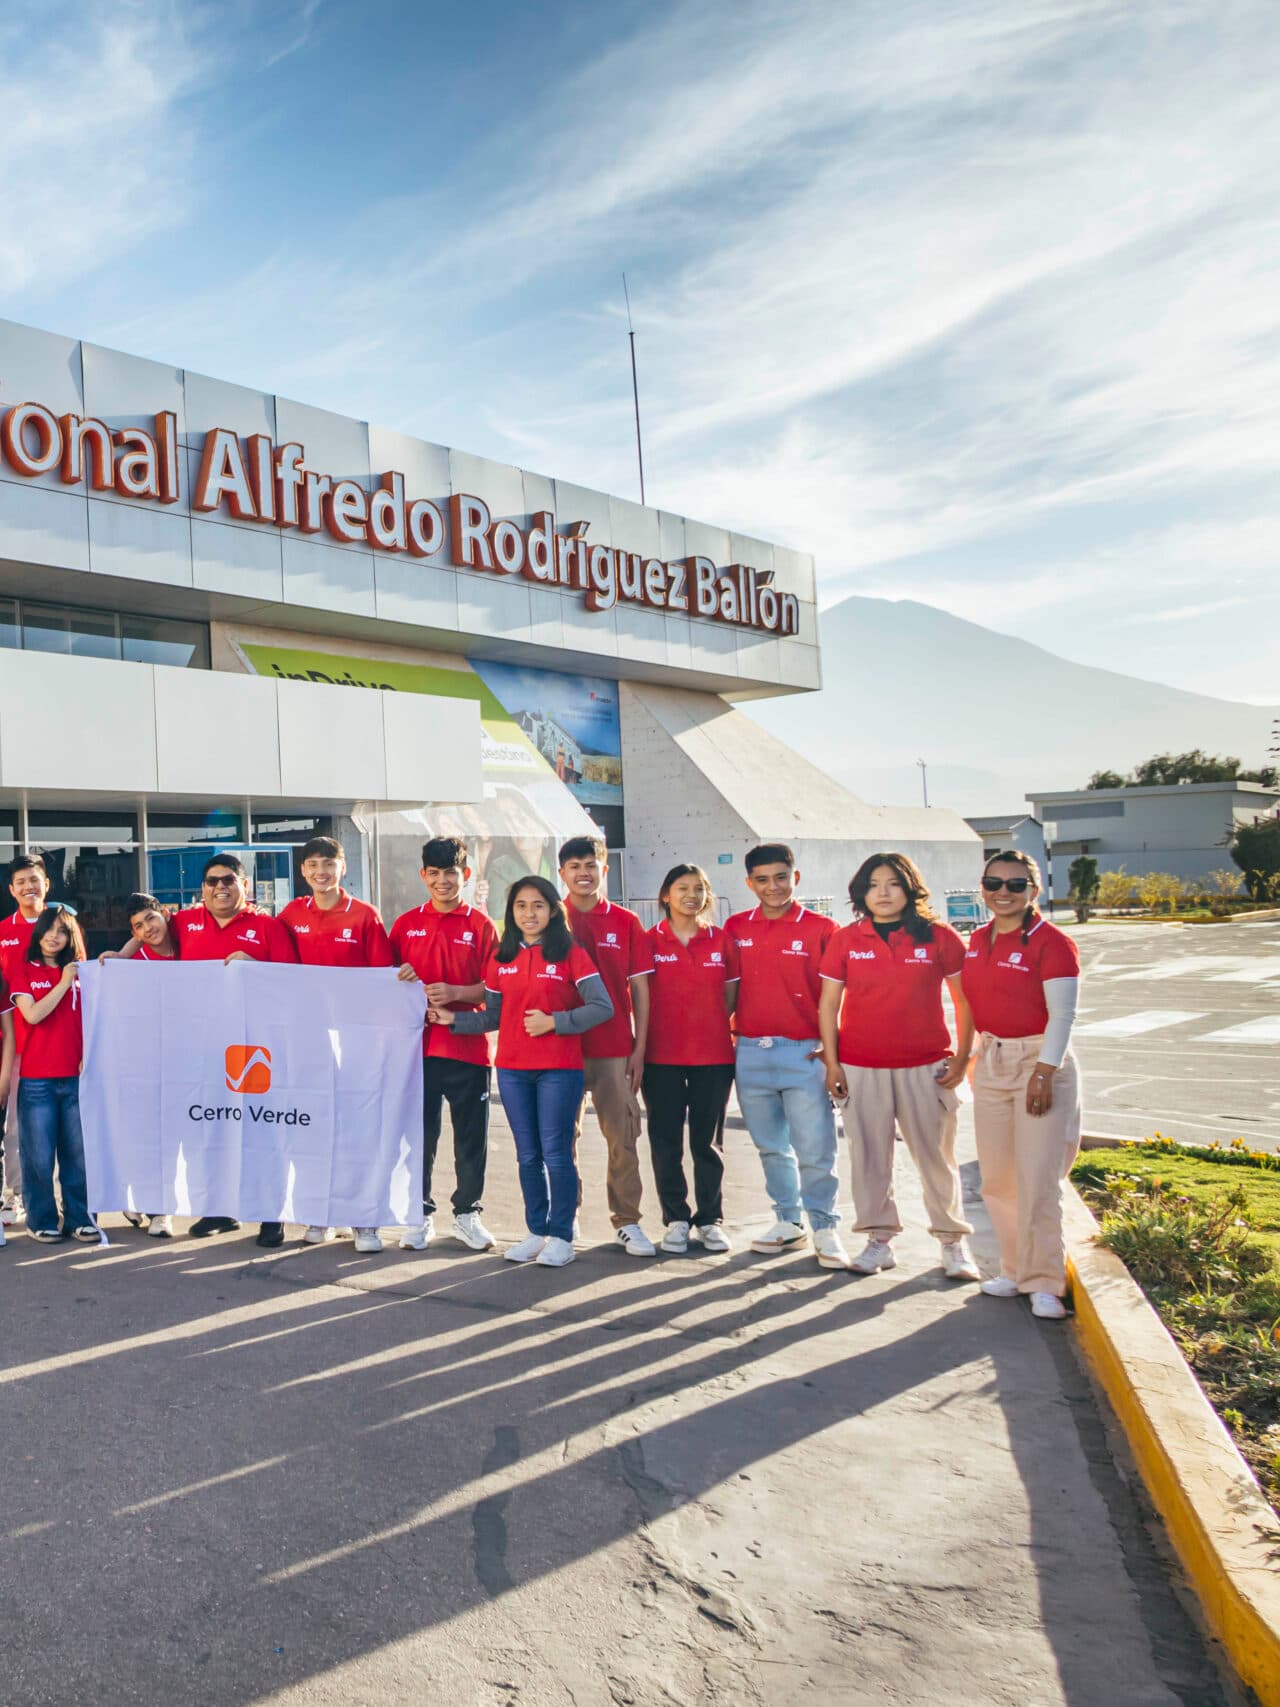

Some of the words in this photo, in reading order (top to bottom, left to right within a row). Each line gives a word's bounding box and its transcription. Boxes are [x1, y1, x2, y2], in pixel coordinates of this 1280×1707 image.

[193, 427, 446, 557] Alfredo
[449, 493, 689, 611] Rodríguez
[686, 556, 800, 636] Ballón
[188, 1104, 242, 1121] Cerro
[248, 1105, 311, 1126] Verde
